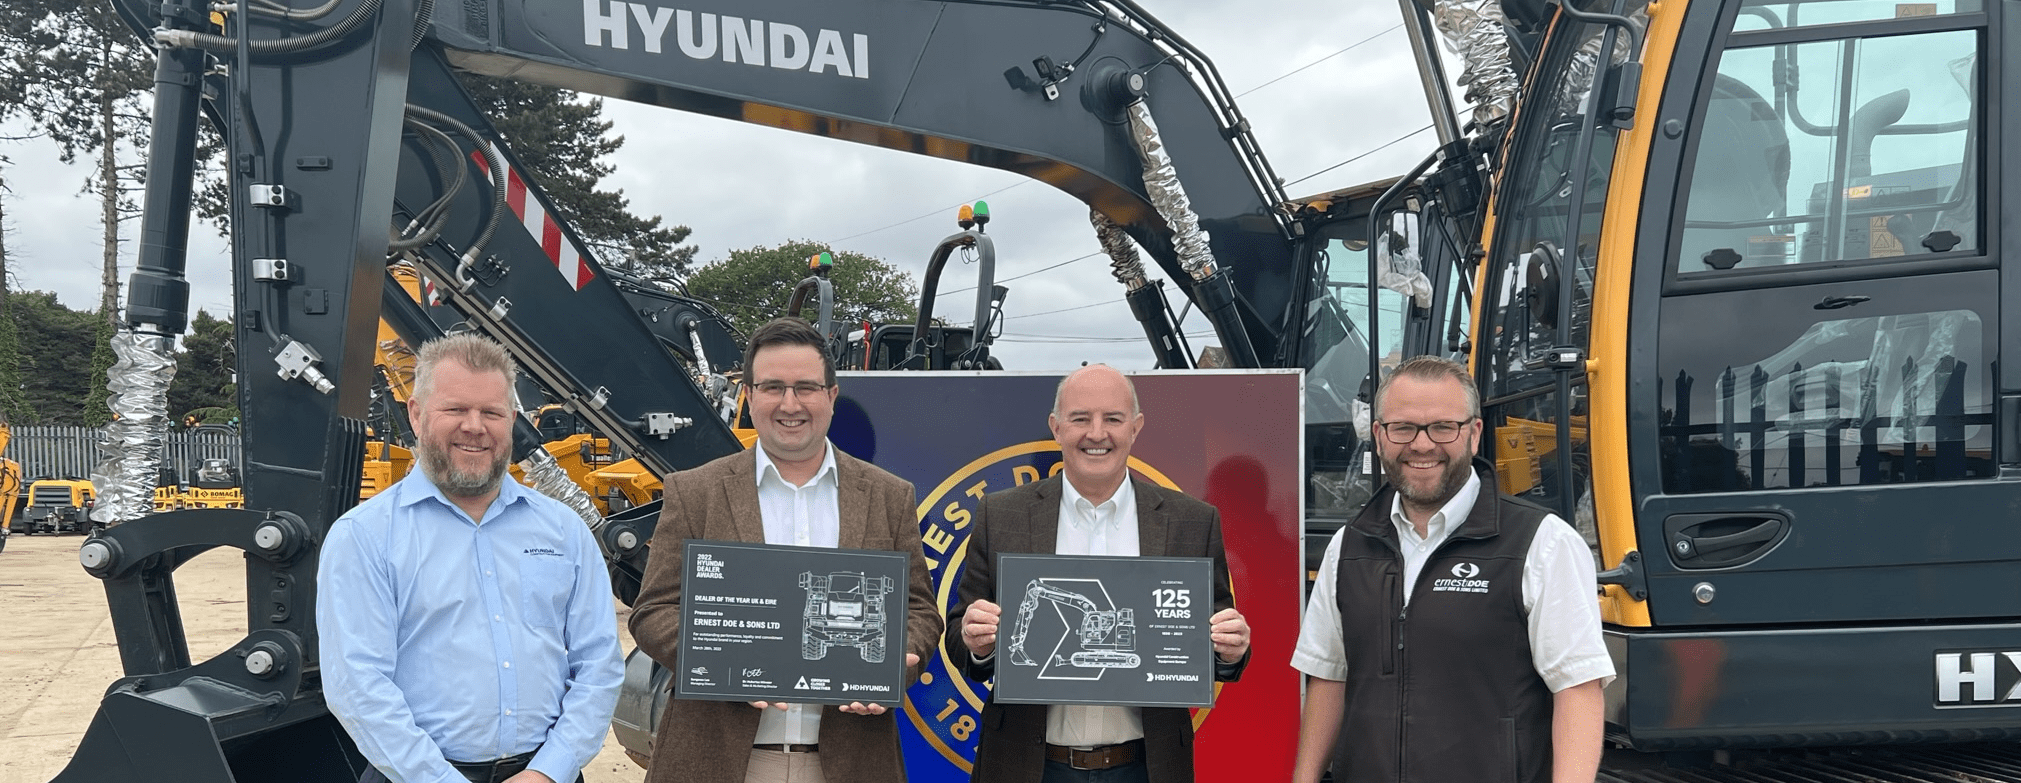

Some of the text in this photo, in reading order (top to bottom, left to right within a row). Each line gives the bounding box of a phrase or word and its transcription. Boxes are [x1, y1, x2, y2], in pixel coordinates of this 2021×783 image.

[583, 0, 869, 79] HYUNDAI
[1152, 588, 1191, 608] 125
[1154, 608, 1191, 619] YEARS
[694, 618, 780, 630] ERNEST DOE & SONS LTD
[1165, 674, 1199, 682] HYUNDAI
[936, 698, 978, 752] 18
